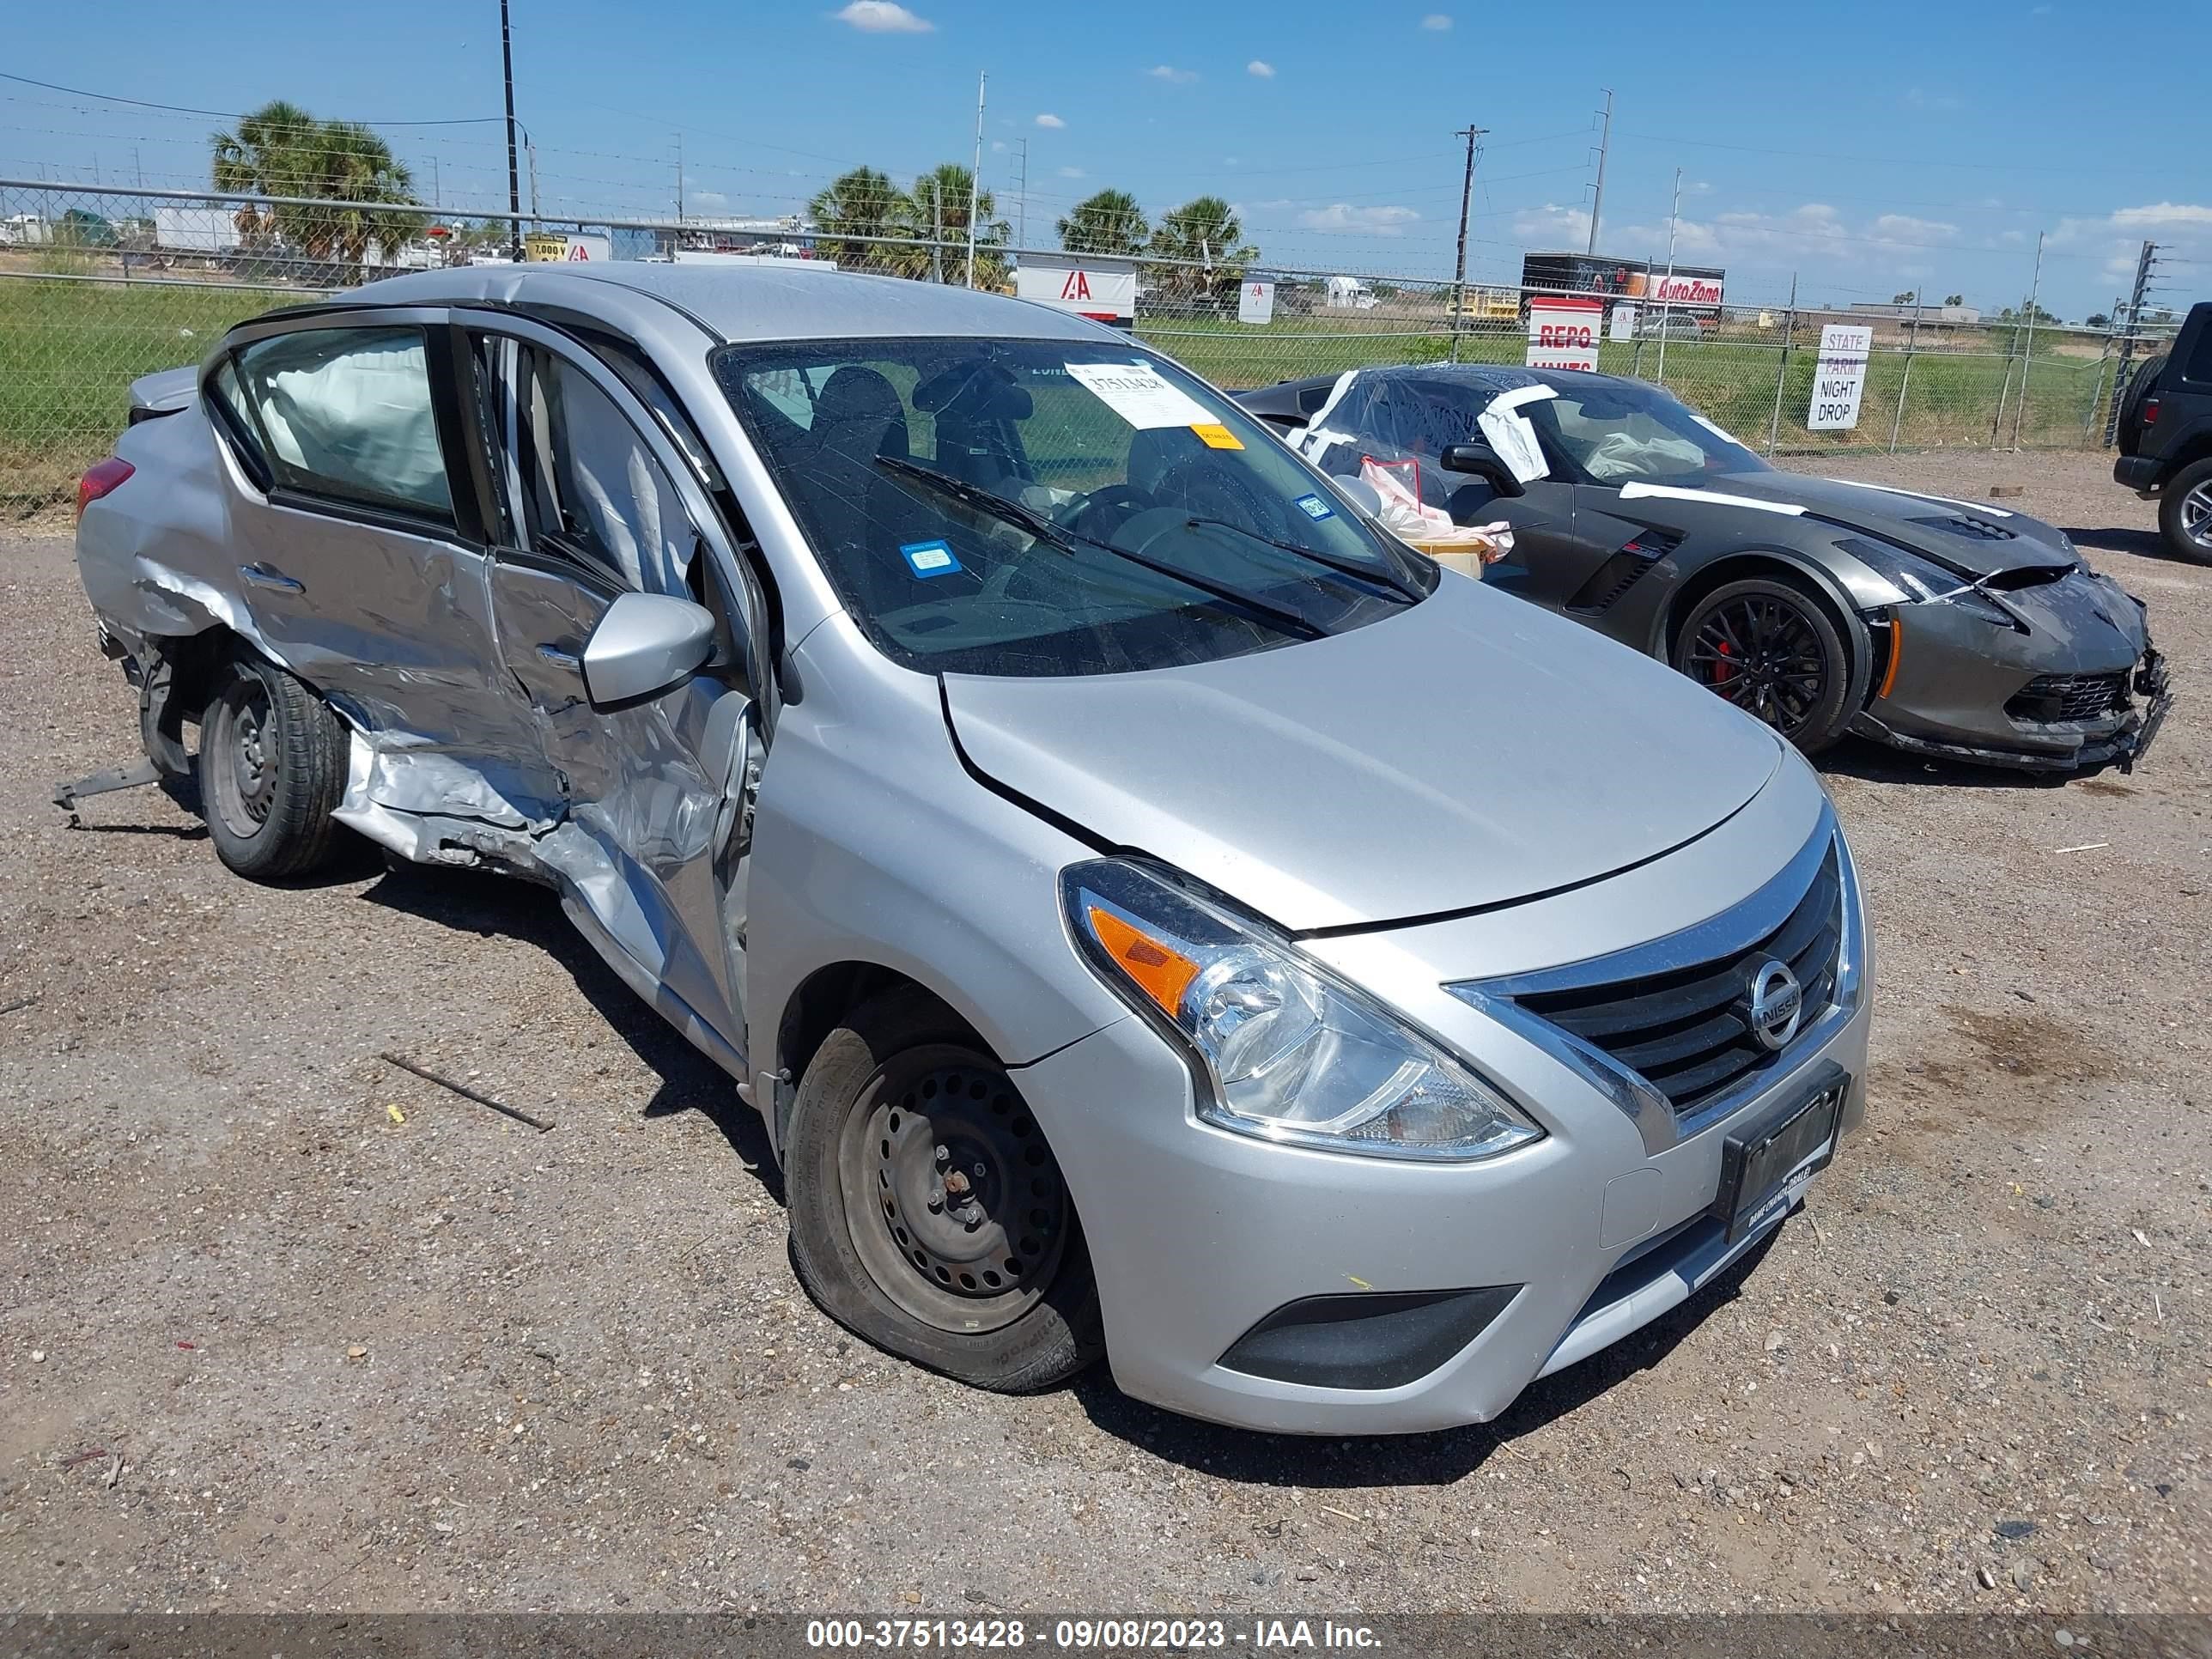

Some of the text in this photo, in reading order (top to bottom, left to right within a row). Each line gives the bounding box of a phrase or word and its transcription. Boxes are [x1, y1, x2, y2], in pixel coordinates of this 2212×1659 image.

[535, 244, 558, 255] 7,000
[1657, 278, 1720, 303] AutoZone
[1540, 325, 1591, 349] REPO
[1828, 333, 1863, 350] STATE
[1826, 357, 1858, 375] FARM
[1089, 378, 1165, 392] 37513428
[1820, 380, 1856, 398] NIGHT
[1818, 404, 1850, 422] DROP
[1748, 1204, 1766, 1228] DAME
[1765, 1186, 1789, 1212] CHANZA
